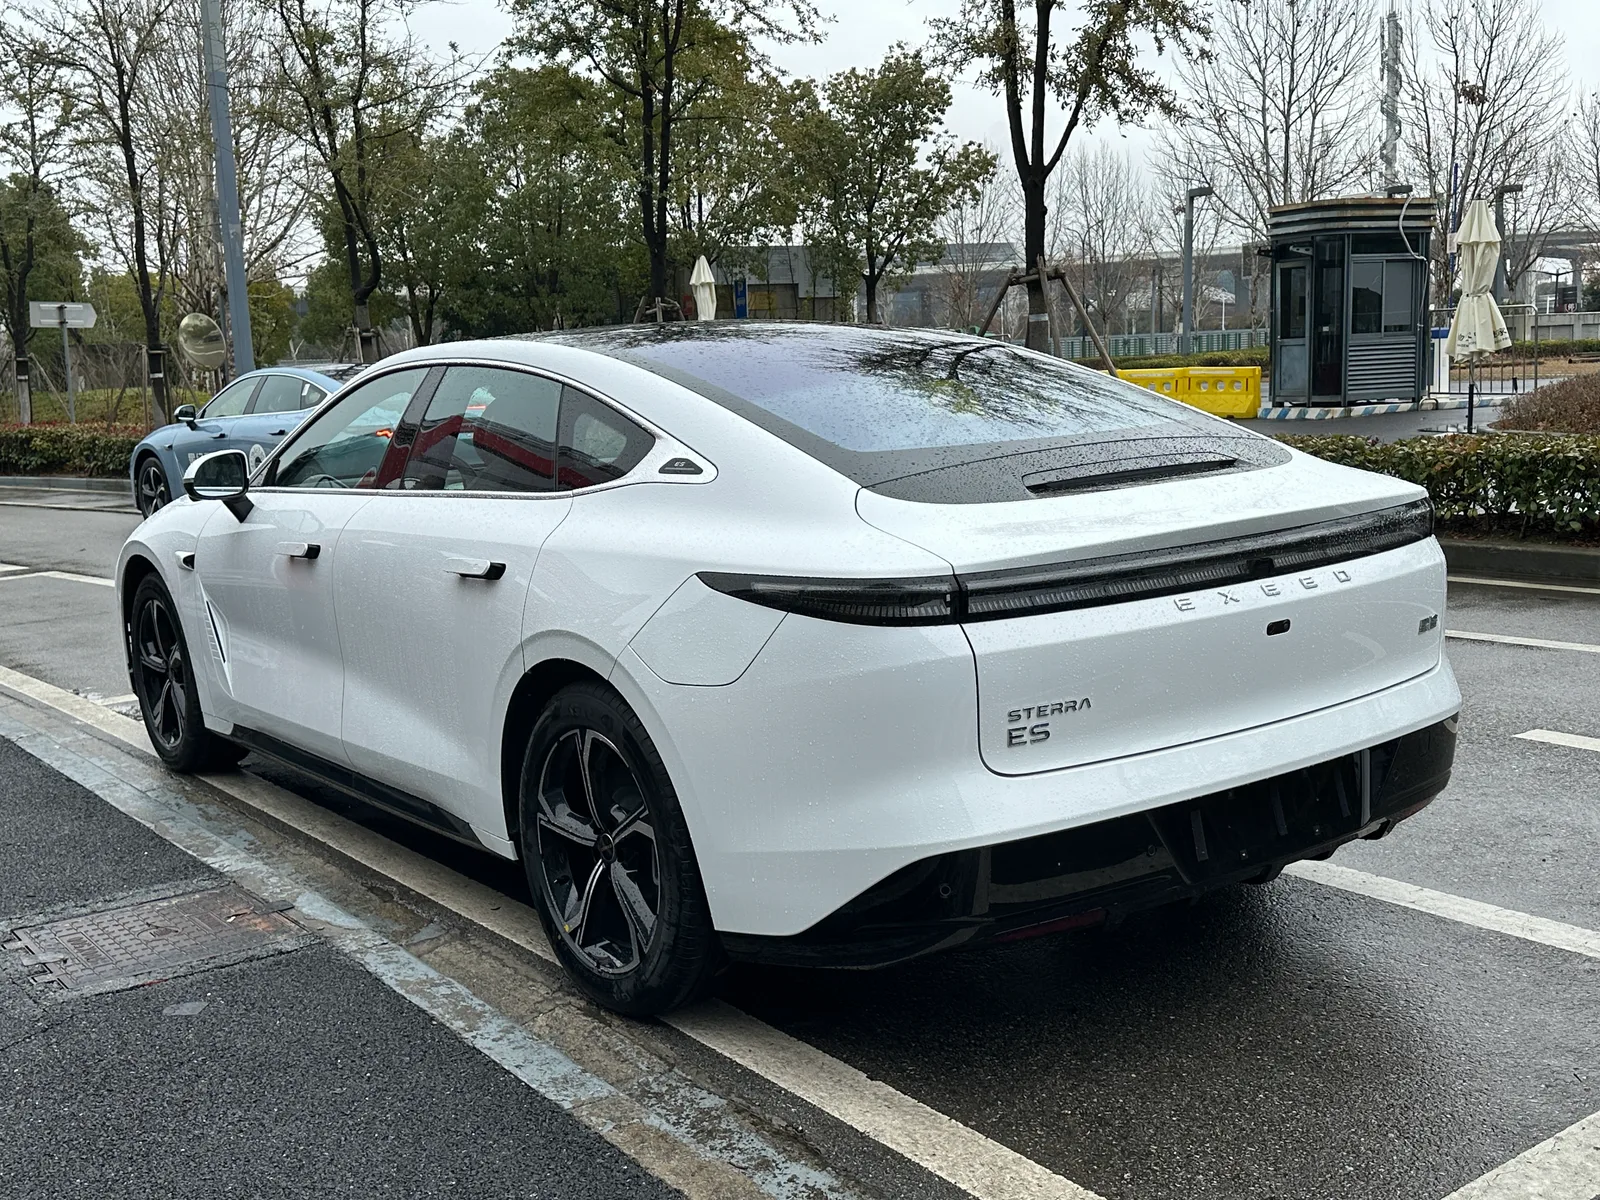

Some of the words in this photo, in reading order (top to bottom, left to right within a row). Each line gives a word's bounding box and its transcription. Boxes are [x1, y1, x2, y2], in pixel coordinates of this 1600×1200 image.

[1174, 570, 1352, 612] EXEED
[1007, 697, 1092, 723] STERRA
[1007, 722, 1050, 748] ES
